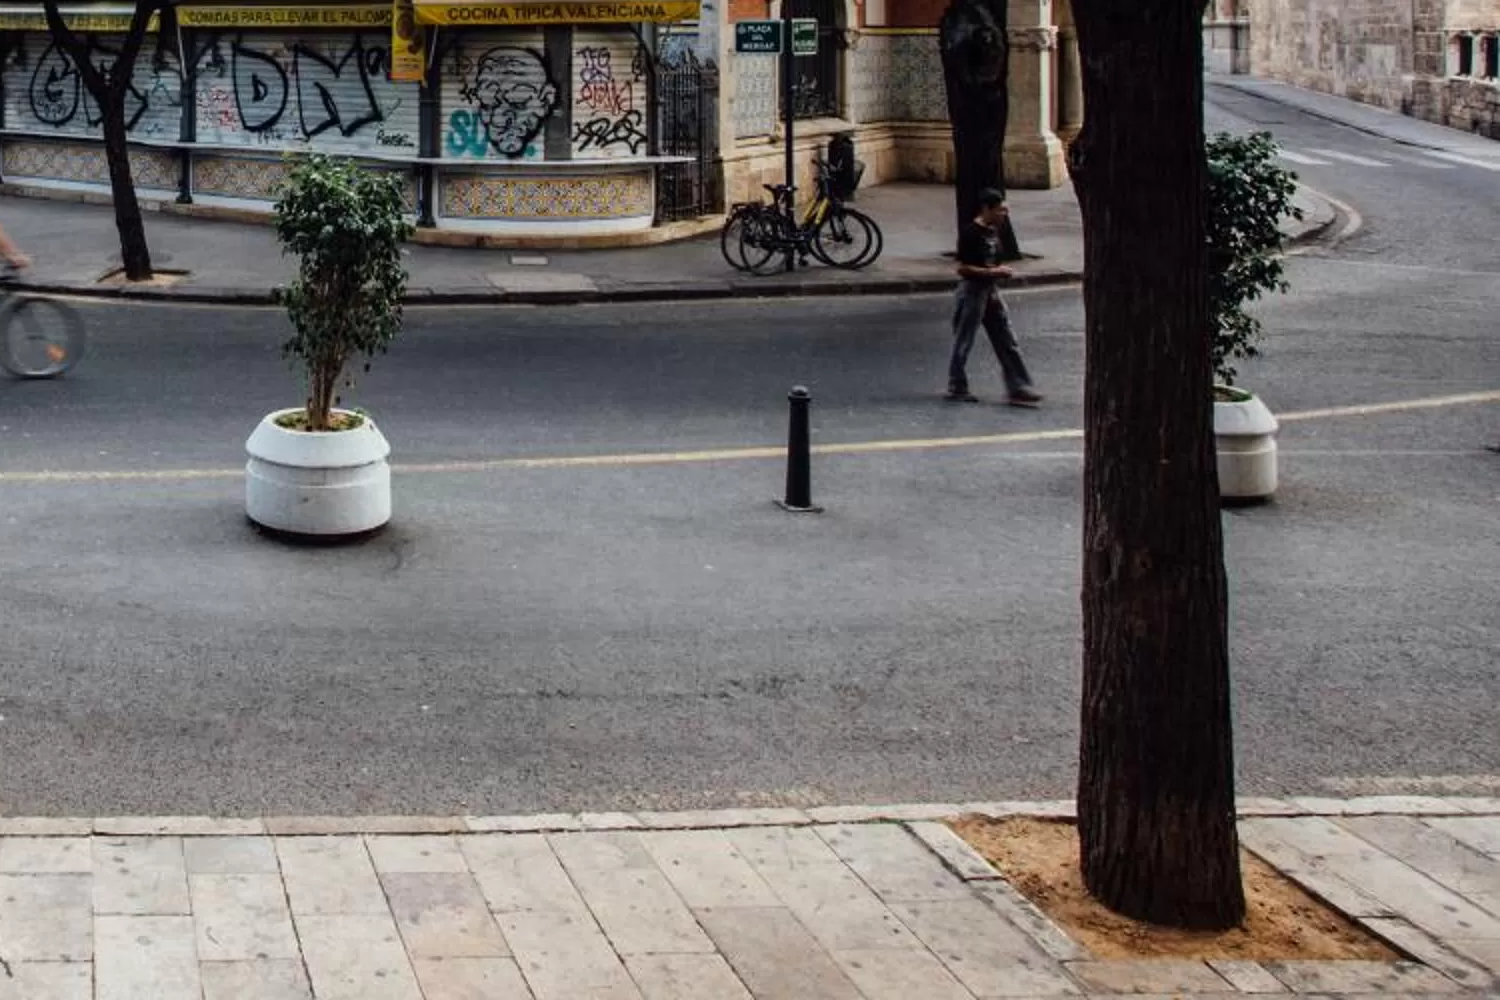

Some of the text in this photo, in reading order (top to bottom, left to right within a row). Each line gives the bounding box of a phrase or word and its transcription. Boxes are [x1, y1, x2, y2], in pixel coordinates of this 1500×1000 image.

[189, 11, 238, 23] COMIDAS
[241, 11, 271, 23] PARA
[273, 10, 320, 23] LLEVAR
[447, 6, 509, 21] COCINA
[566, 3, 666, 19] VALENCIANA
[747, 25, 772, 34] PLAÇA
